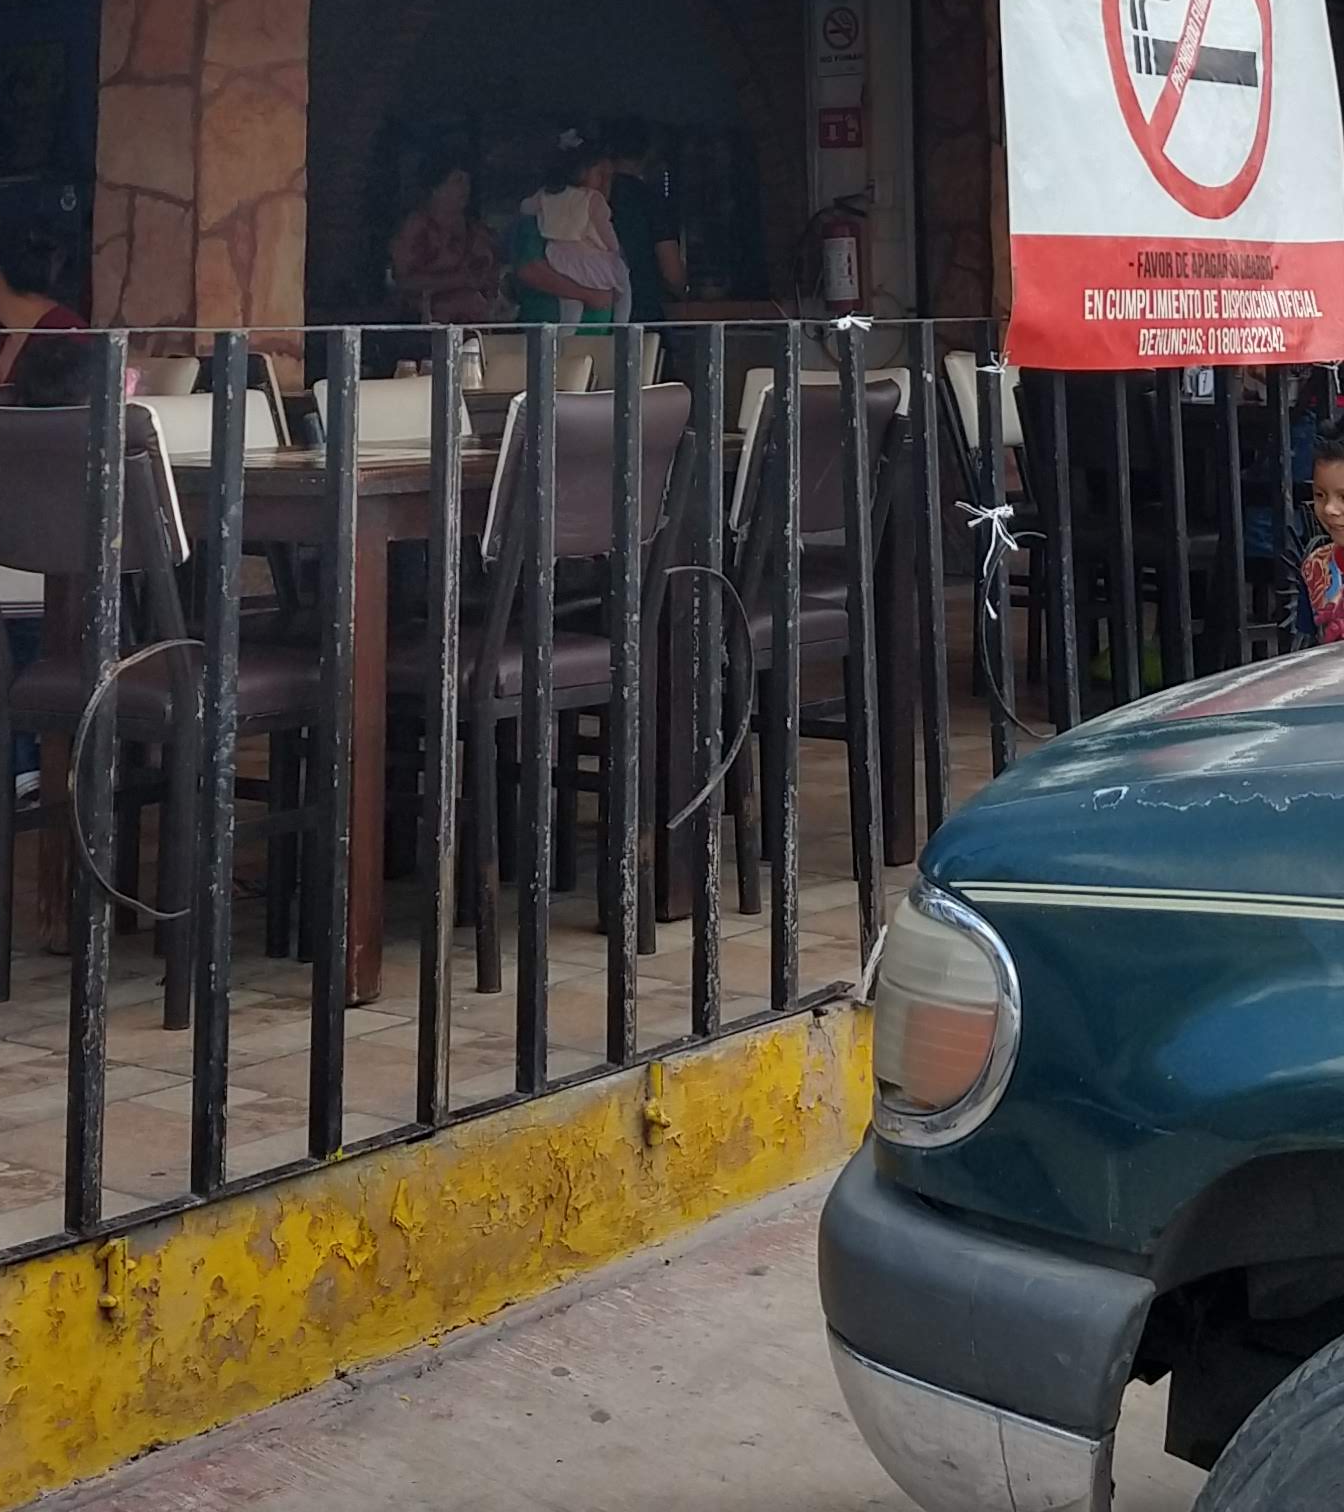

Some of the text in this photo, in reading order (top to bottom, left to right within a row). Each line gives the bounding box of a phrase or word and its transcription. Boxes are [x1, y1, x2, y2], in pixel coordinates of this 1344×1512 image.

[1171, 16, 1201, 95] PROHIBIDO
[1137, 251, 1173, 279] FAVOR
[1175, 252, 1189, 279] DE
[1191, 253, 1228, 280] APAGAR
[1084, 285, 1323, 321] EN CUMPLIMIENTO DE DISPOSICIÓN OFICIAL
[1139, 327, 1206, 356] DENUNCIAS:
